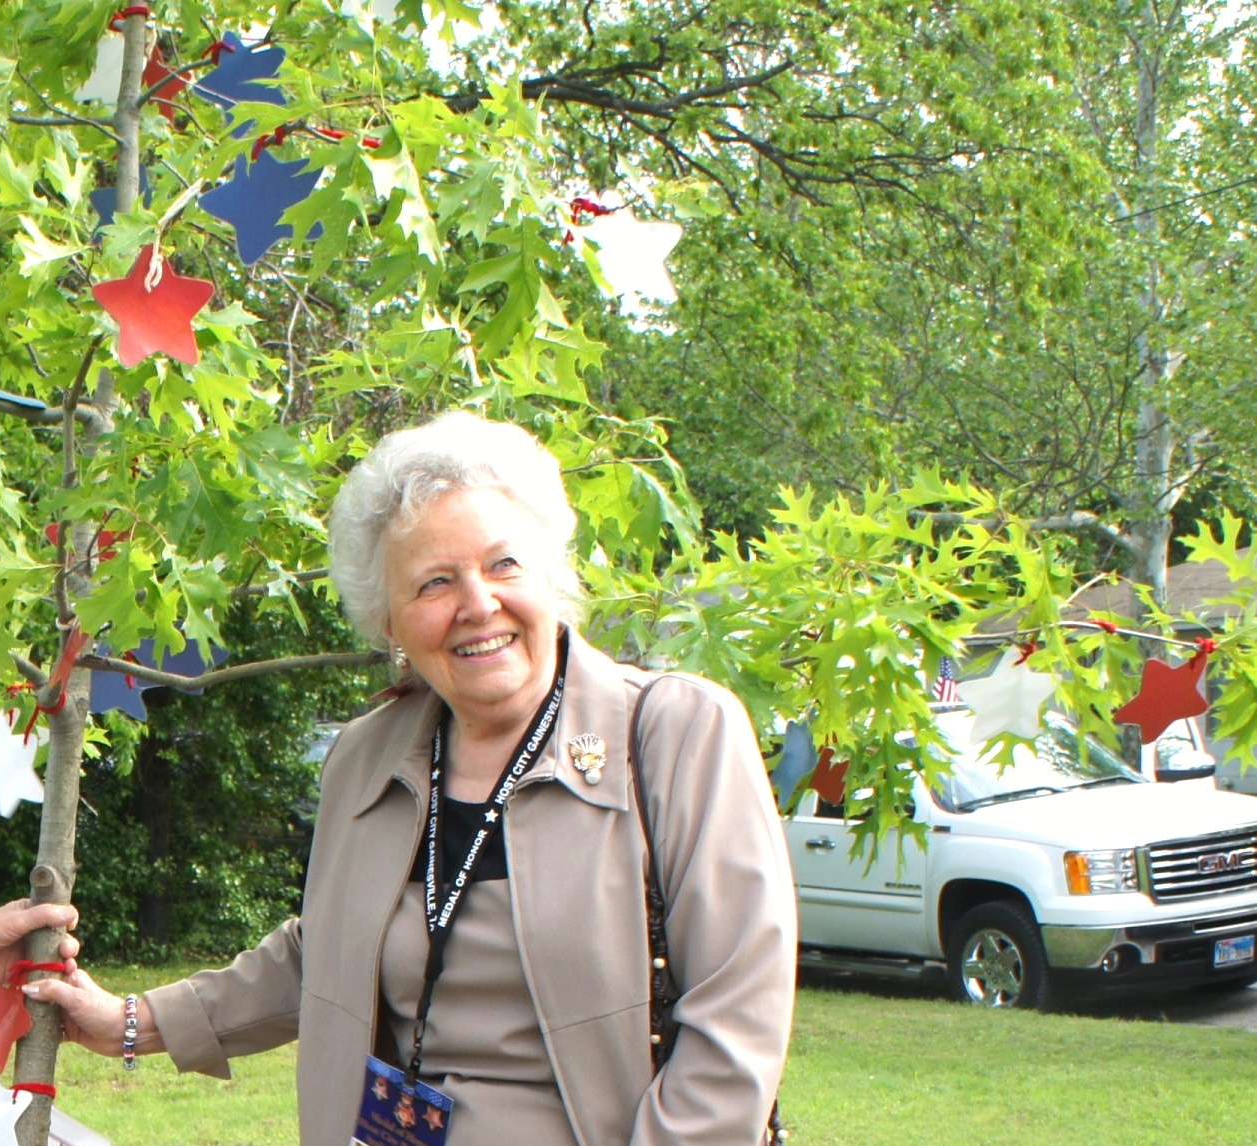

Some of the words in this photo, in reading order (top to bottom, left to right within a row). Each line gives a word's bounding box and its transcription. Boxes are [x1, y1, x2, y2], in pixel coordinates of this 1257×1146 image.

[430, 785, 438, 814] HOST
[429, 816, 437, 839] CITY
[437, 889, 461, 928] MEDAL
[455, 870, 468, 887] OF
[462, 829, 488, 871] HONOR
[494, 774, 517, 805] HOST
[512, 750, 532, 776] CITY
[1198, 848, 1257, 874] GMC
